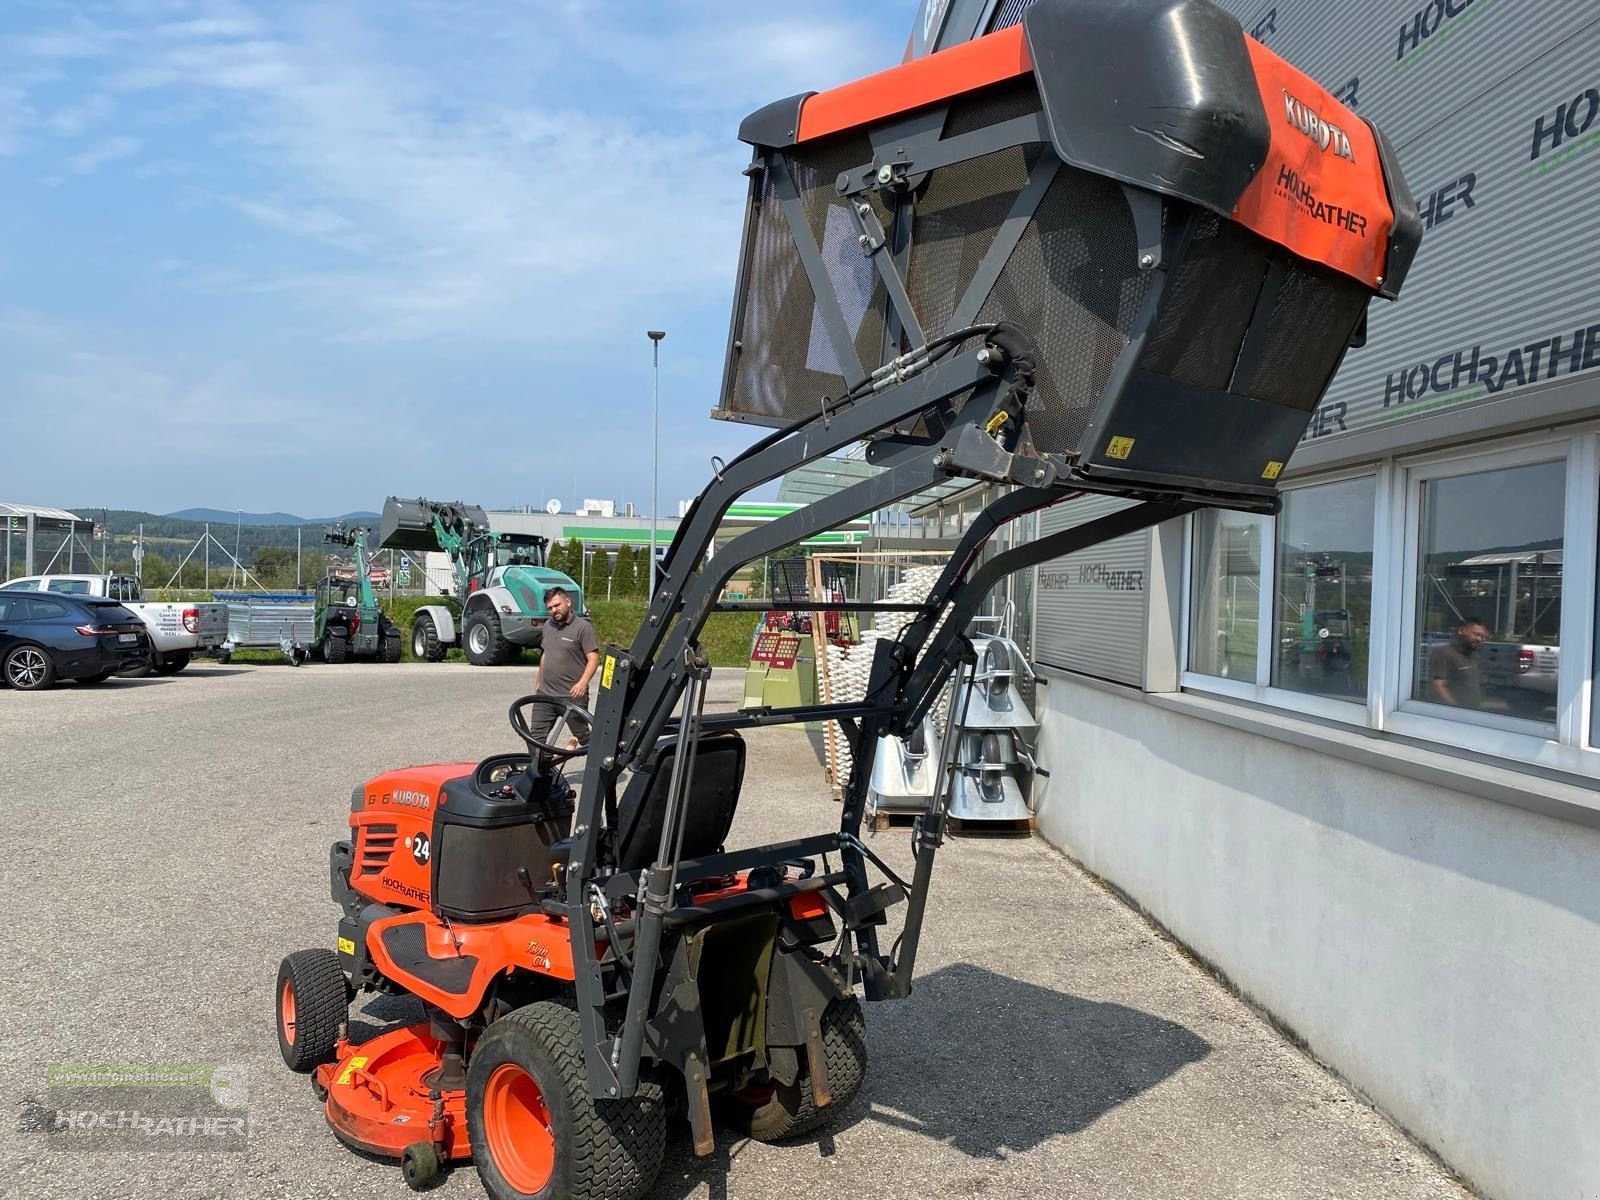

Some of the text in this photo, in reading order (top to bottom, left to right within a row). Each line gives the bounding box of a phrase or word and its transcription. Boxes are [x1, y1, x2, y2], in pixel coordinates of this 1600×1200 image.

[1283, 88, 1355, 164] KUBOTA
[1277, 163, 1368, 238] HOCHRATHER
[1079, 563, 1143, 591] HOCHRATHER
[392, 789, 430, 810] KUBOTA
[414, 837, 430, 860] 24
[382, 876, 430, 904] HOCHRATHER
[526, 941, 549, 958] Twin
[532, 955, 551, 969] Cu
